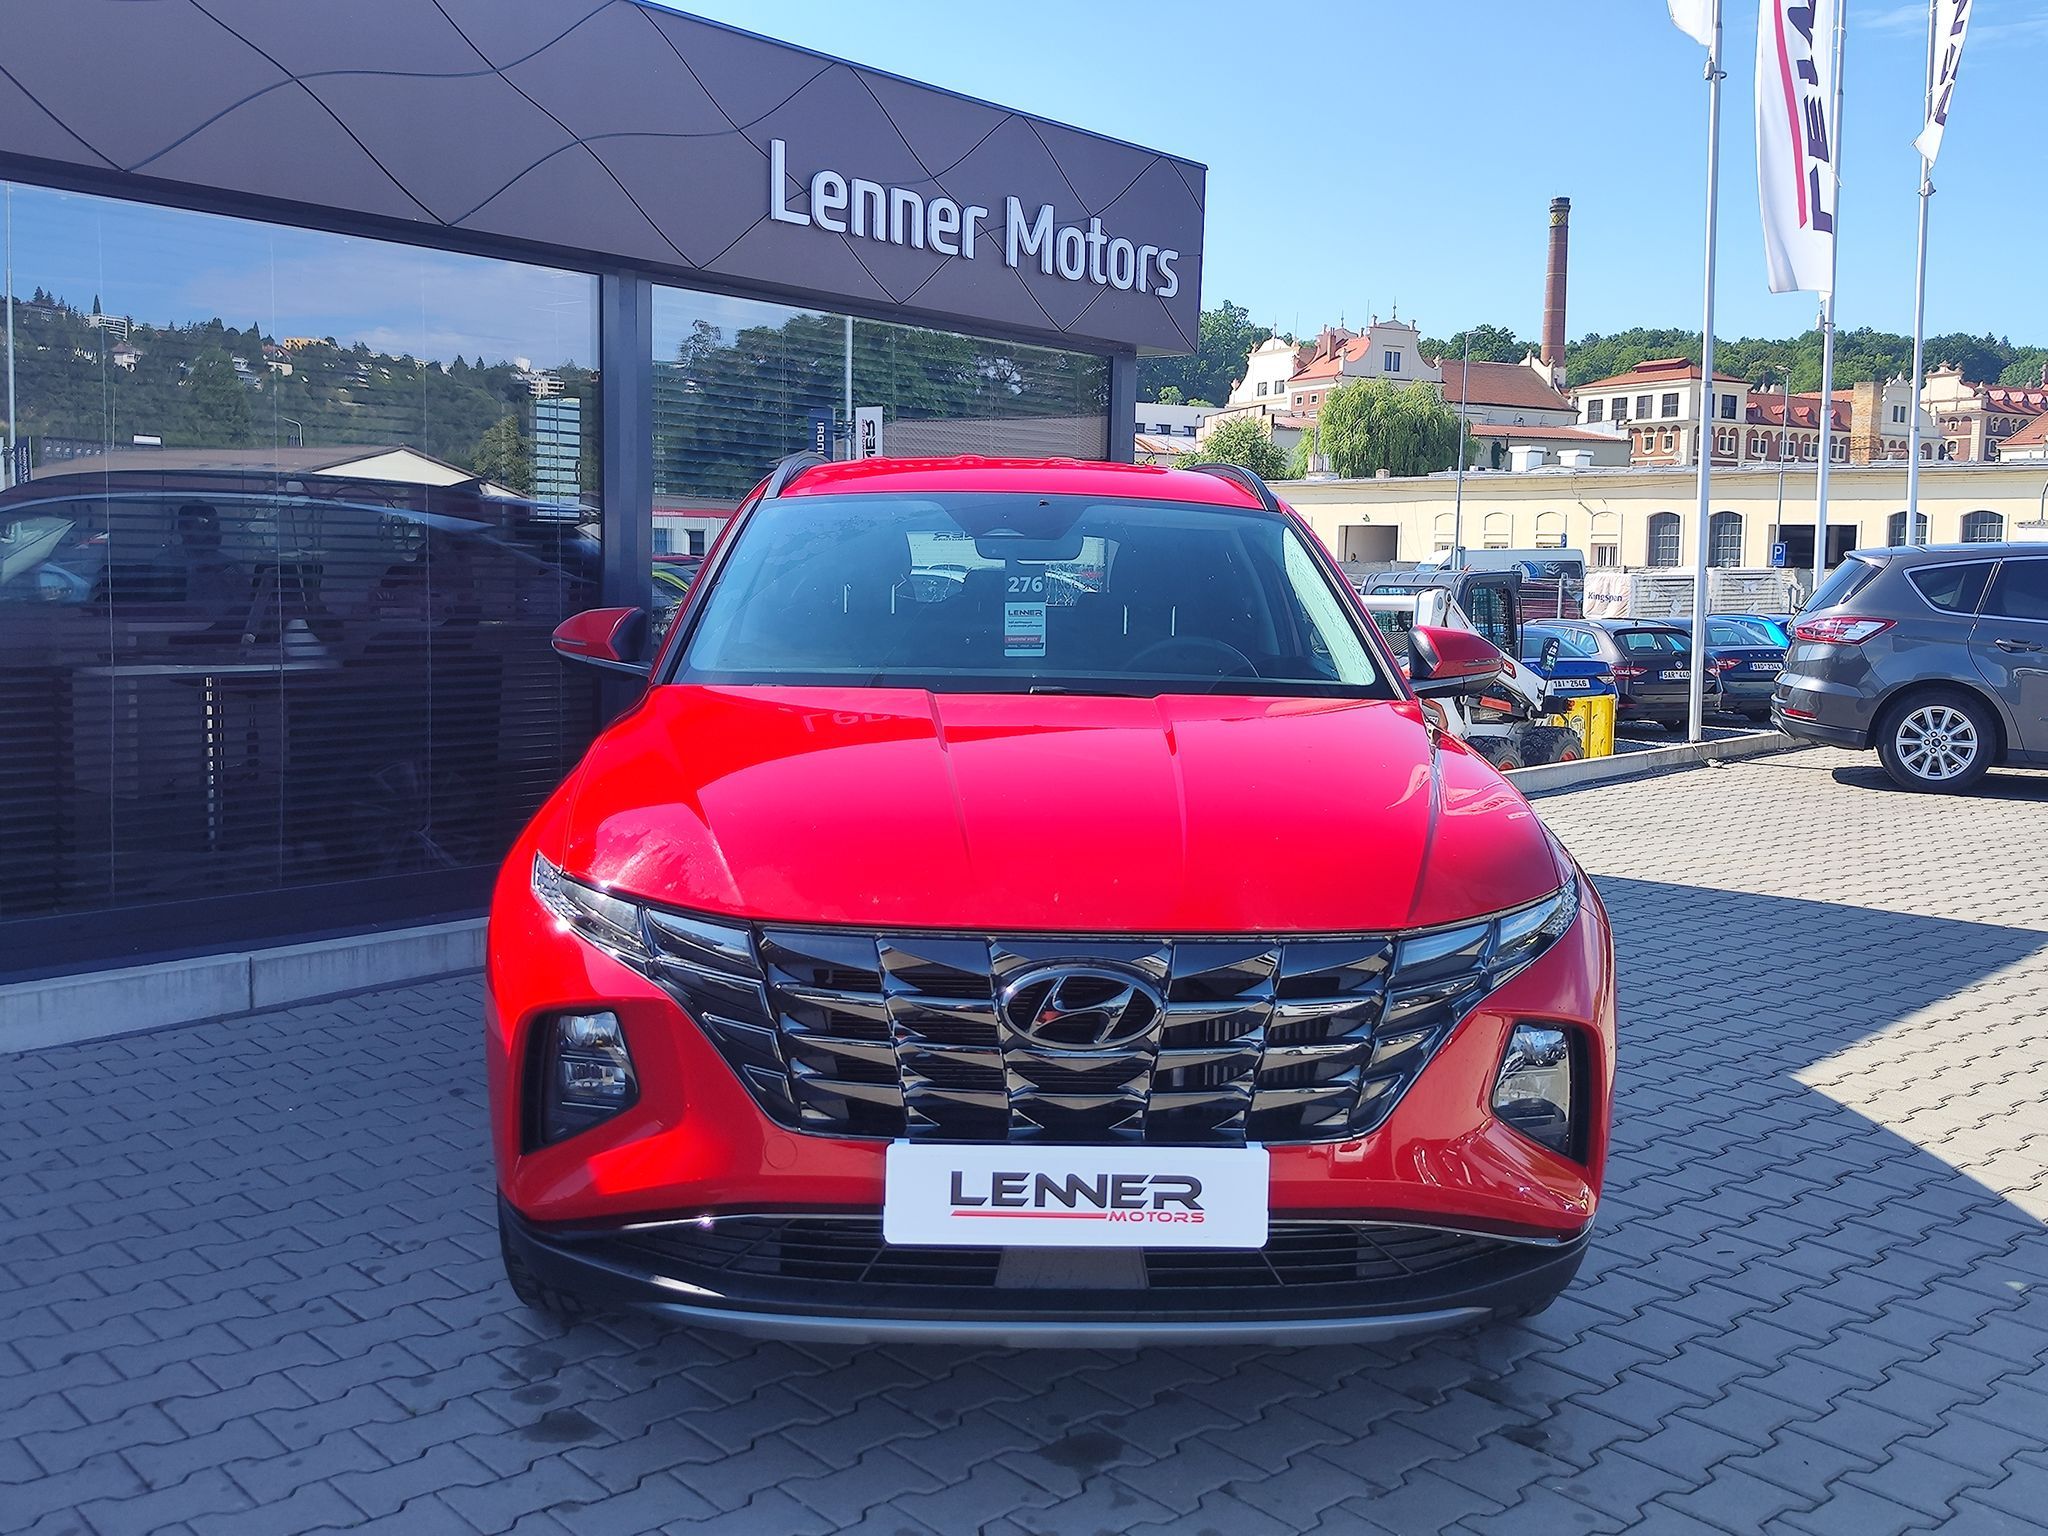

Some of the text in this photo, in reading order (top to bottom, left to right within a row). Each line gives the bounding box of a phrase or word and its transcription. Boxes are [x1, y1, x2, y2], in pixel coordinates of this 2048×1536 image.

[770, 138, 1180, 298] Lenner Motors
[1774, 546, 1782, 559] P
[1008, 576, 1043, 593] 276
[1587, 592, 1622, 603] Kingspan
[950, 1170, 1204, 1210] LENNER
[1107, 1210, 1205, 1224] MOTORS
